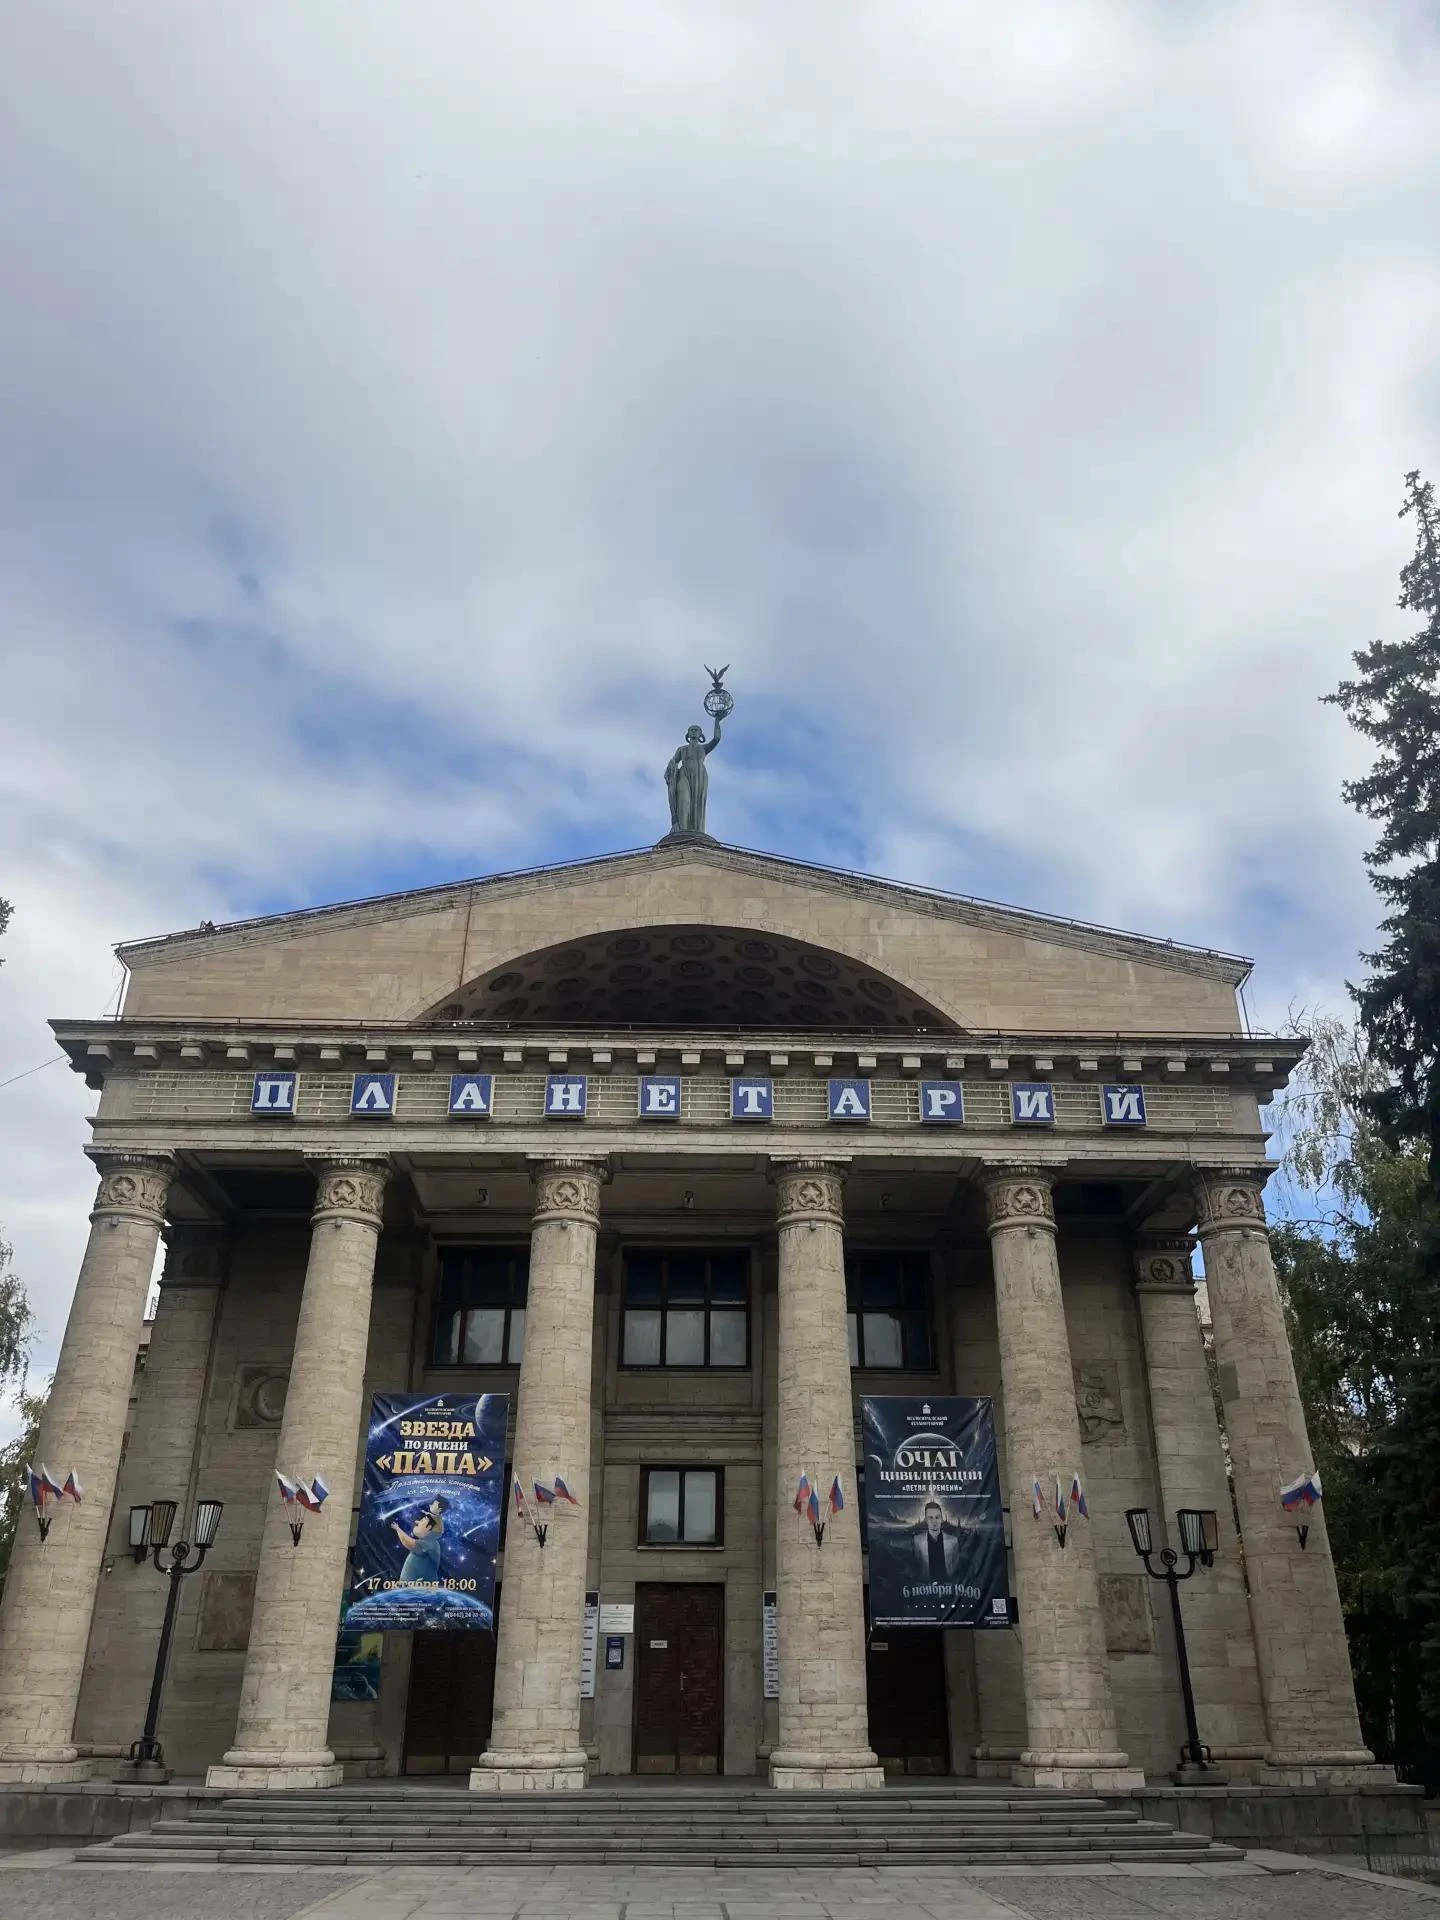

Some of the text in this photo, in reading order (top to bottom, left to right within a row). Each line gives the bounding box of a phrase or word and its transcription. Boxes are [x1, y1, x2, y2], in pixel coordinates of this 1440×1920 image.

[257, 1080, 1143, 1121] ПЛАНЕТАРИЙ
[400, 1420, 475, 1440] ЗВЕЗДА
[404, 1440, 468, 1451] ПО ИМЕНИ
[375, 1451, 494, 1475] «ПАПА»
[896, 1450, 964, 1468] ОЧАГ
[880, 1470, 983, 1483] ЦИВИЛИЗАЦИИ
[367, 1577, 477, 1592] 17 октября 18:00
[902, 1585, 910, 1598] 6
[911, 1581, 953, 1598] ноября
